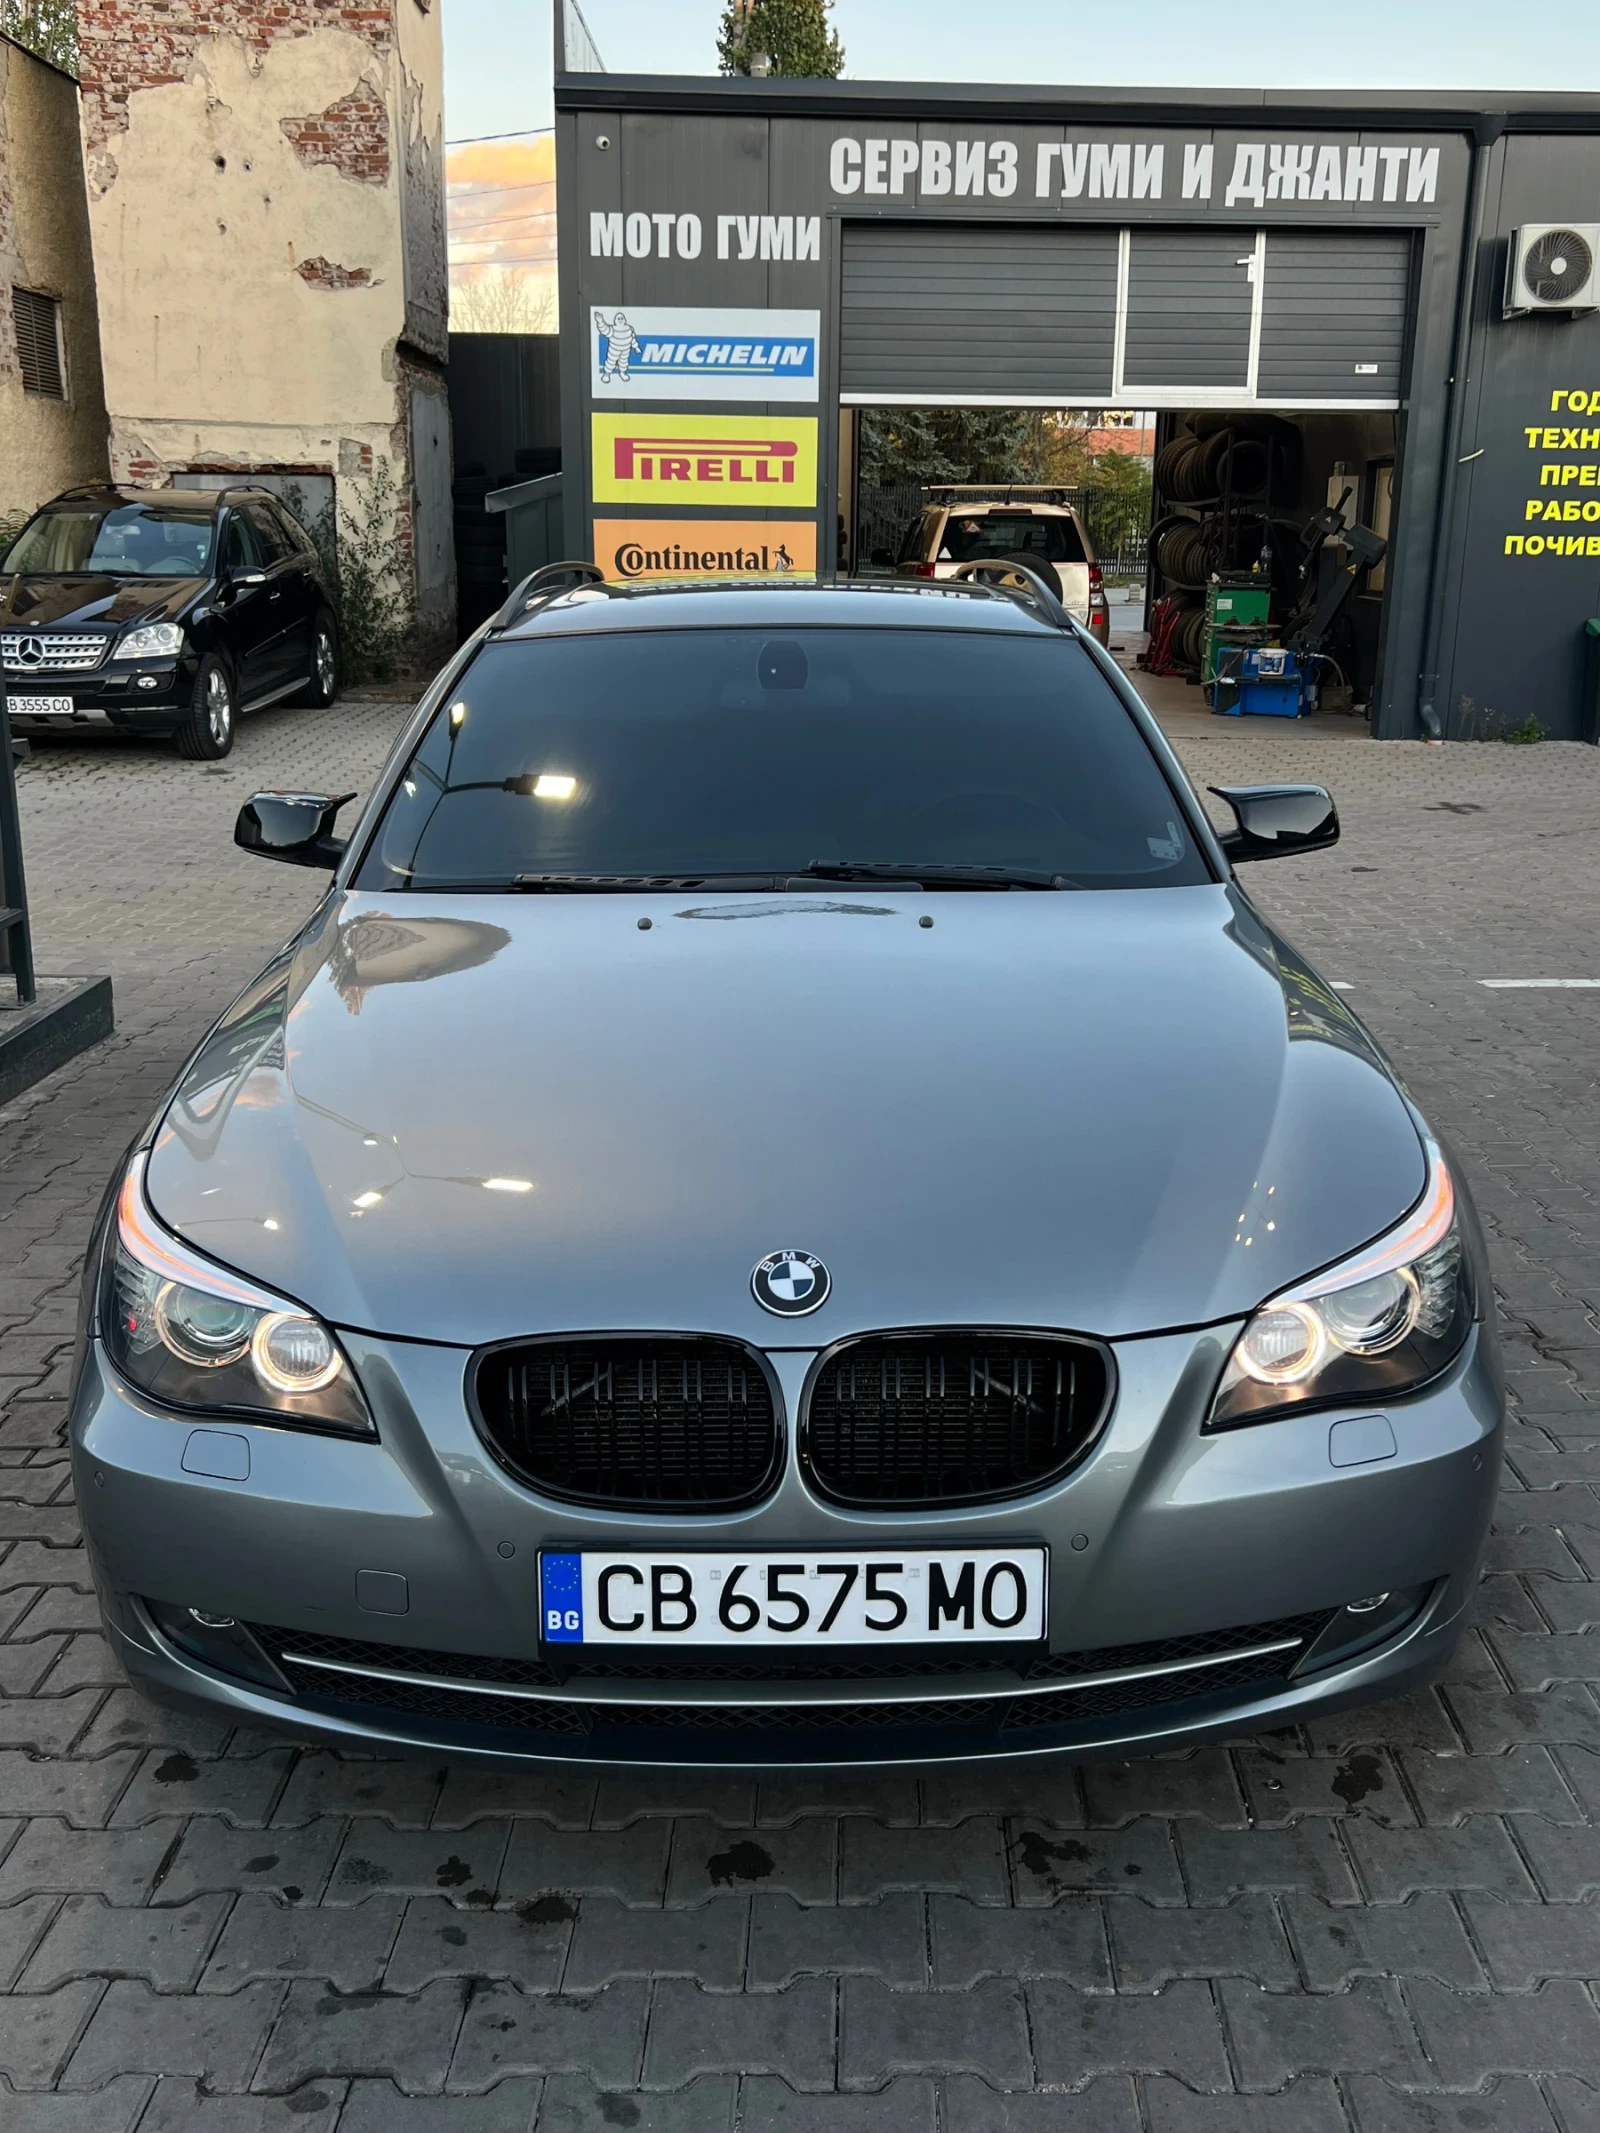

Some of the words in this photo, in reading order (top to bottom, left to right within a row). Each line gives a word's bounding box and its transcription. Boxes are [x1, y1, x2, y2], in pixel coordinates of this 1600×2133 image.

[830, 138, 1019, 198] СЕРВИЗ
[1036, 143, 1165, 199] ГУМИ
[1182, 144, 1215, 200] И
[1225, 143, 1441, 207] ДЖАНТИ
[590, 212, 702, 260] МОТО
[717, 215, 821, 261] ГУМИ
[641, 343, 809, 366] MICHELIN
[614, 438, 798, 483] PIRELLI
[1540, 465, 1600, 486] ПРЕ
[615, 543, 770, 577] Continental
[20, 698, 51, 711] 3555
[760, 1251, 821, 1272] BMW
[597, 1564, 697, 1632] CB
[718, 1563, 908, 1633] 6575
[928, 1561, 1027, 1630] MO
[547, 1610, 580, 1630] BG
